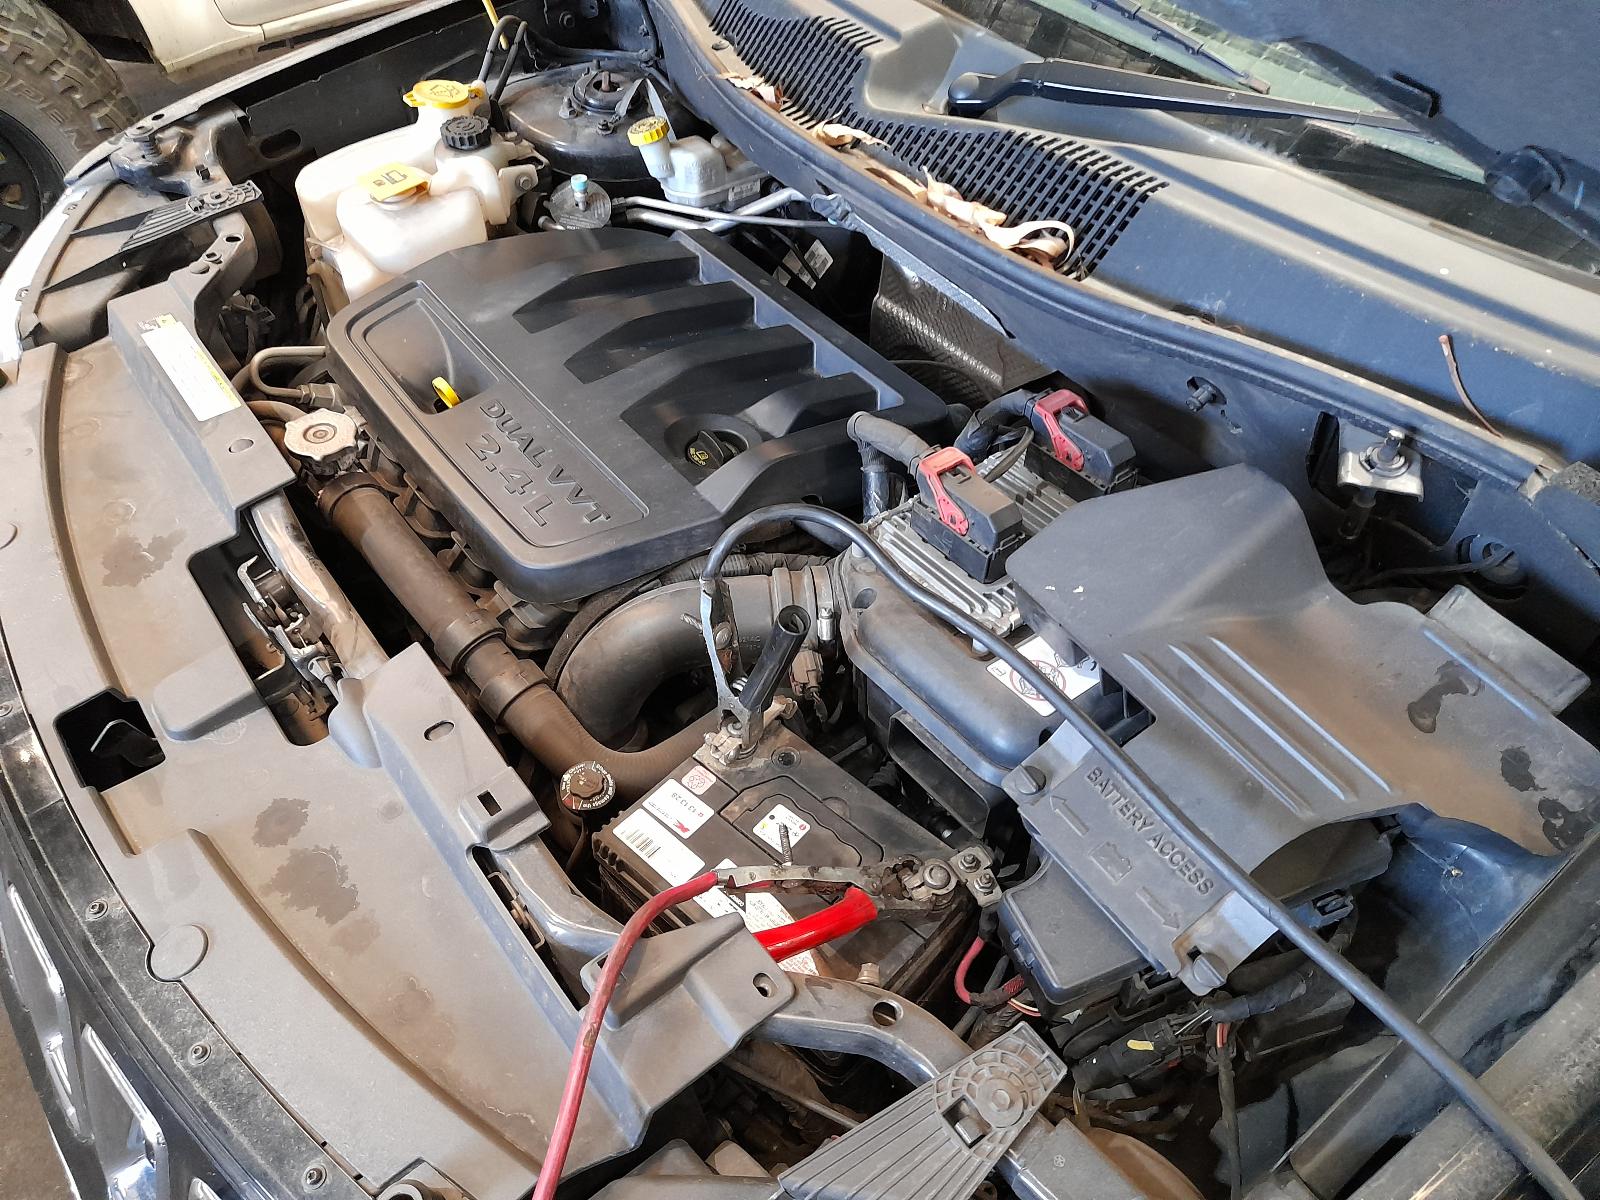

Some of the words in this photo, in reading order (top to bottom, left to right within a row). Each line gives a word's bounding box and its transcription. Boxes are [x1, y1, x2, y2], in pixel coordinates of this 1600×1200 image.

[479, 400, 546, 468] DUAL
[547, 464, 611, 524] VVT
[1086, 766, 1155, 832] BATTERY
[1146, 831, 1214, 895] ACCESS
